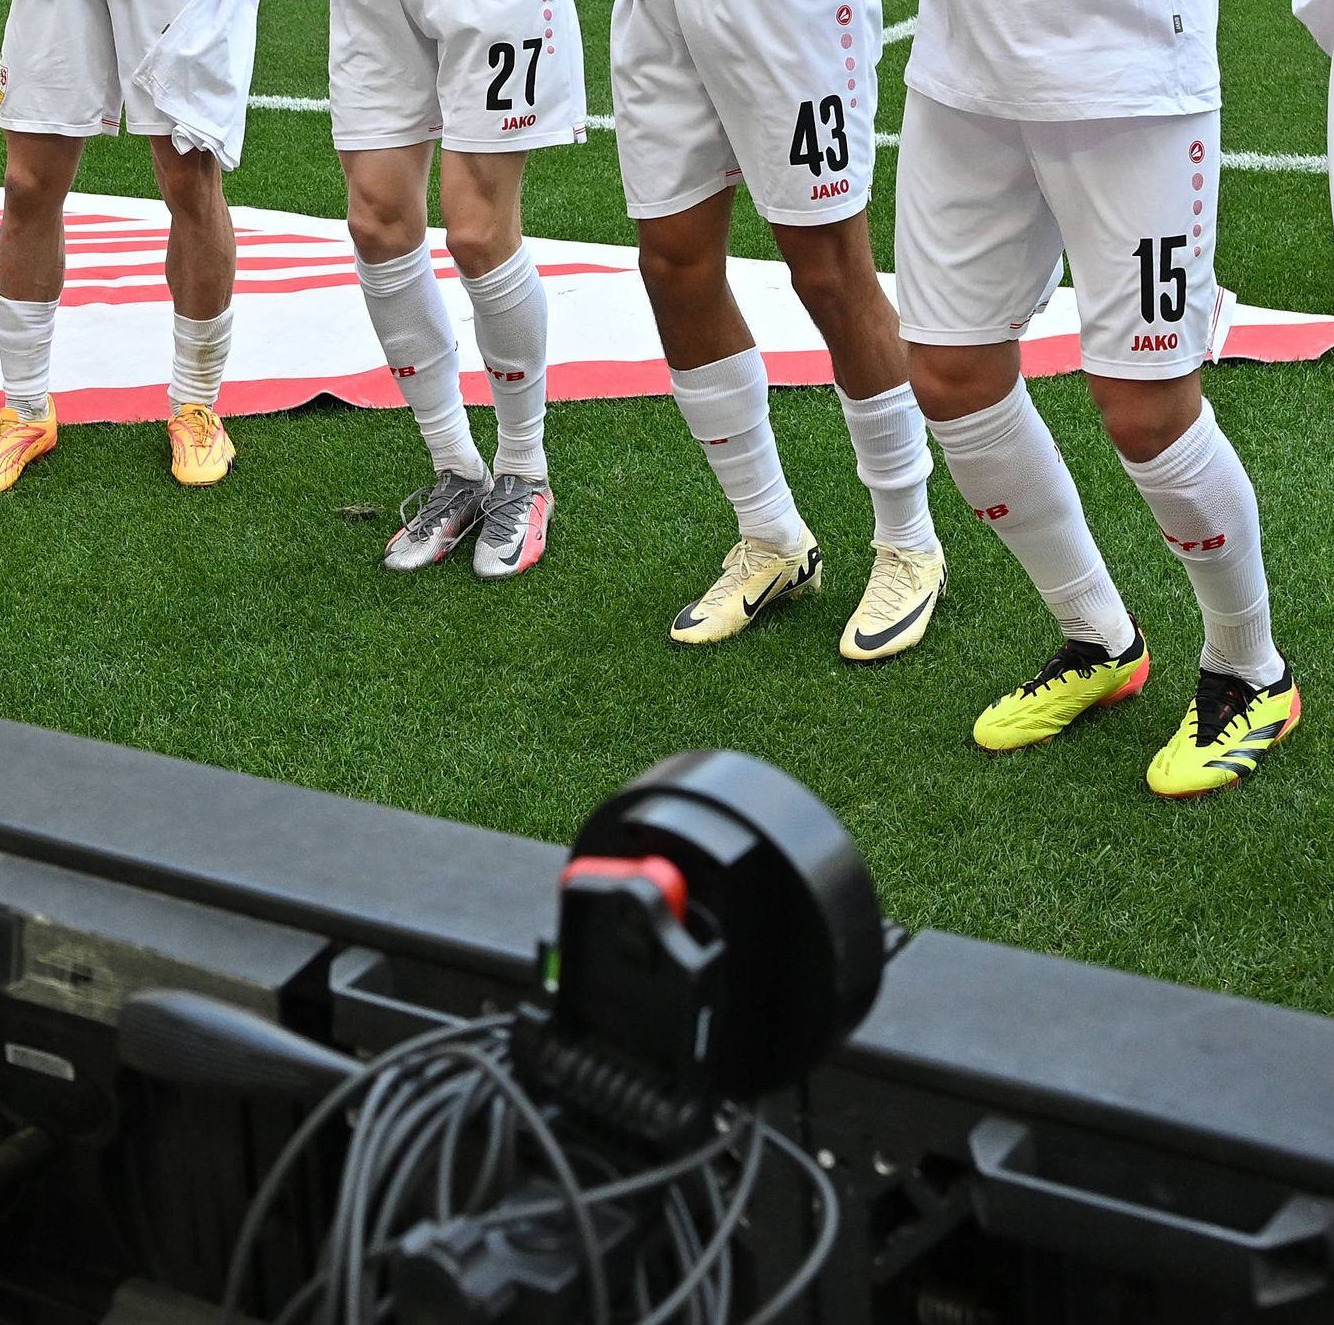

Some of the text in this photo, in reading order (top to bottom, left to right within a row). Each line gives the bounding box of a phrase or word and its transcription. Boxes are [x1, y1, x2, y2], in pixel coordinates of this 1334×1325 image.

[486, 38, 542, 110] 27
[502, 114, 536, 130] JAKO
[790, 95, 849, 177] 43
[811, 179, 849, 200] JAKO
[1132, 235, 1186, 324] 15
[1132, 333, 1178, 351] JAKO
[390, 366, 416, 379] fB
[974, 503, 1010, 521] fB
